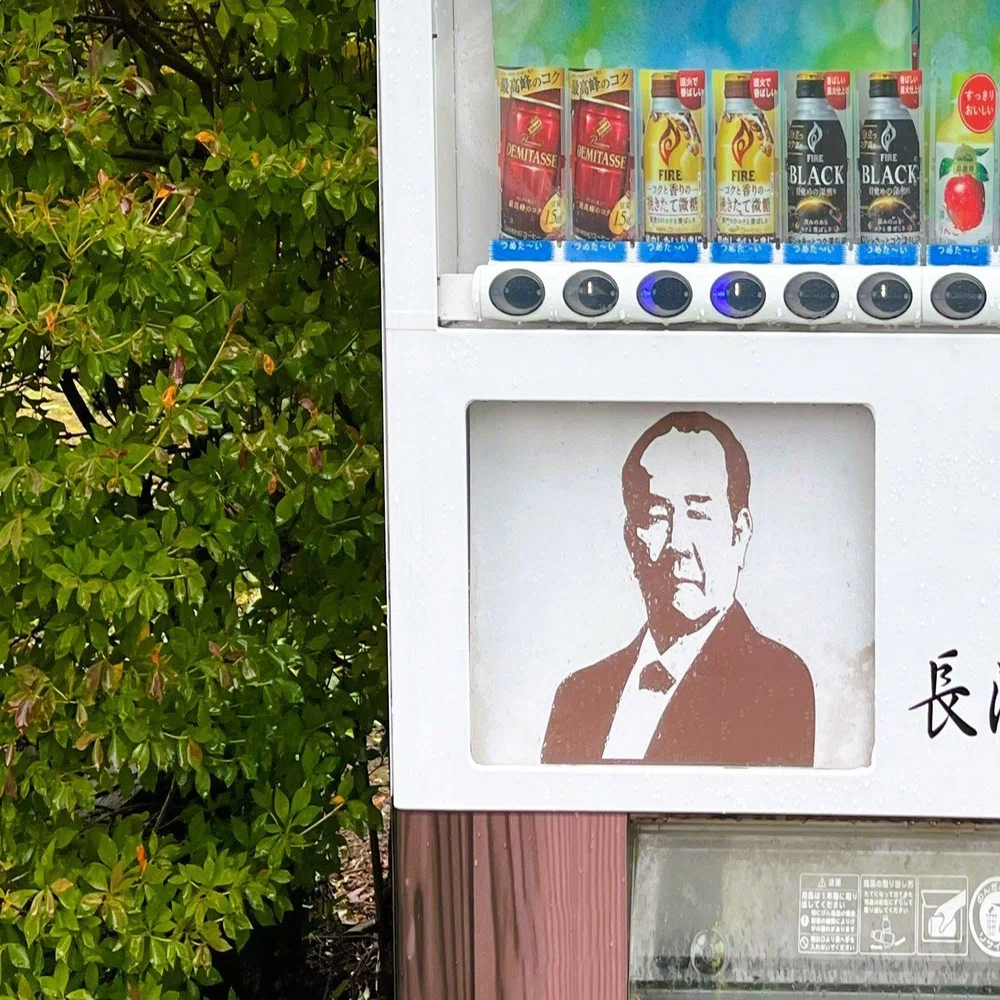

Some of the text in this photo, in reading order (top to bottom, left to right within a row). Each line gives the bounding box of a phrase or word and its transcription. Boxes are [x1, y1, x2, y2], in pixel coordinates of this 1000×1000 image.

[500, 70, 560, 93] 最高峰のコク
[570, 71, 629, 93] 最高峰のコク
[965, 89, 994, 101] すっきり
[965, 105, 994, 116] おいしい
[506, 144, 559, 168] DEMITASSE
[576, 145, 628, 169] DEMITASSE
[807, 153, 824, 163] FIRE
[880, 153, 898, 163] FIRE
[658, 169, 682, 182] FIRE
[731, 169, 756, 182] FIRE
[790, 165, 844, 185] BLACK
[862, 165, 917, 185] BLACK
